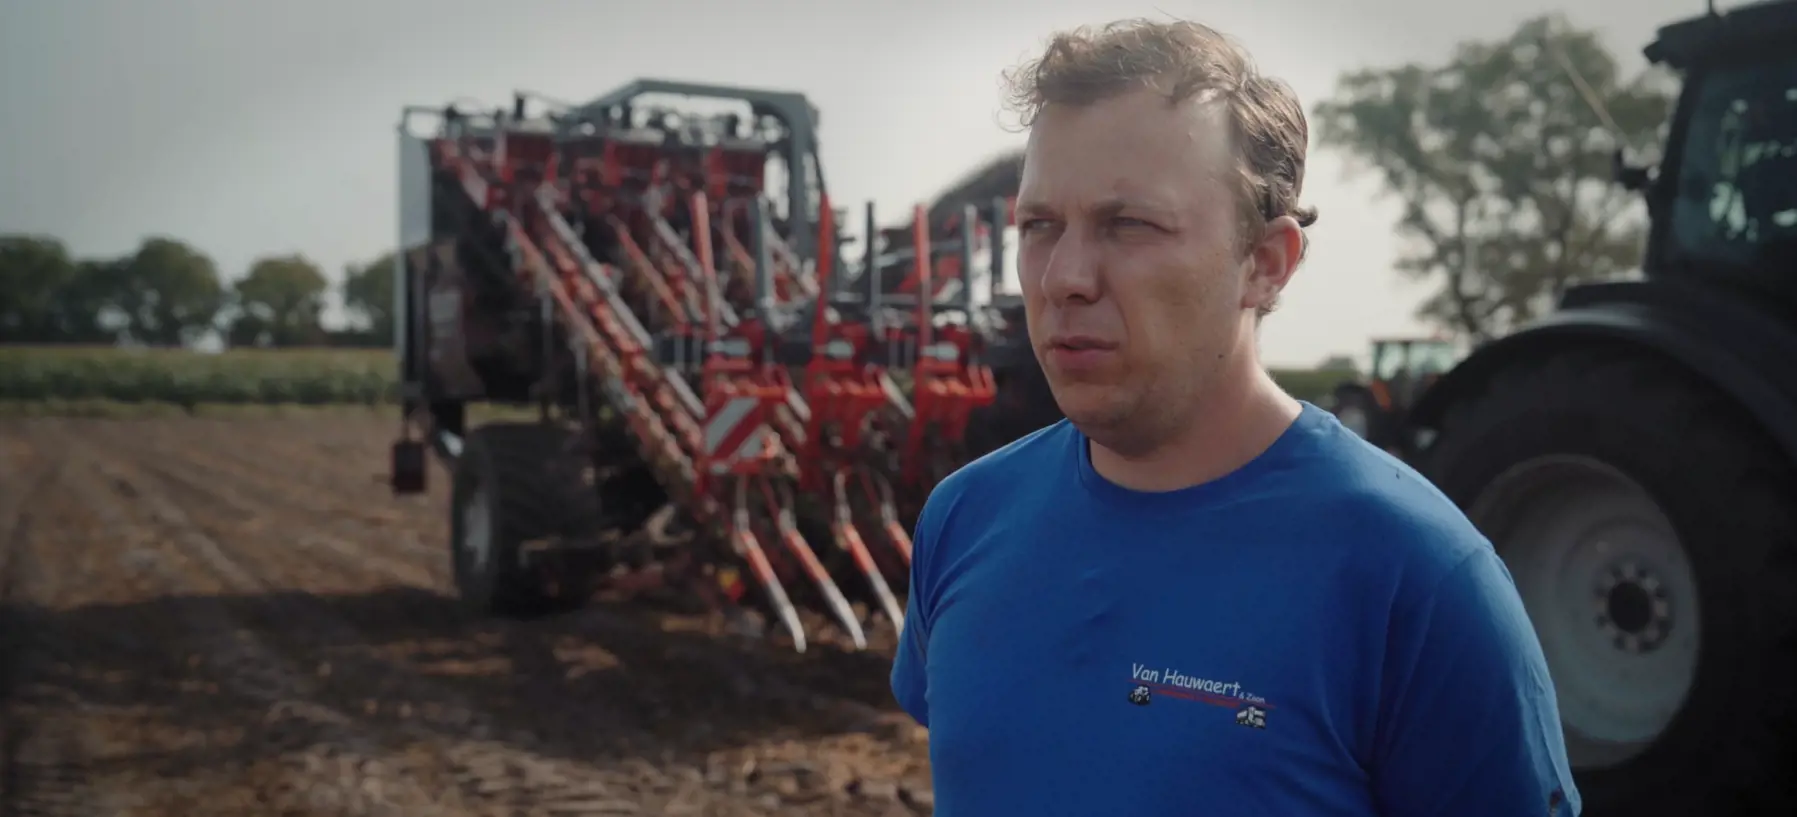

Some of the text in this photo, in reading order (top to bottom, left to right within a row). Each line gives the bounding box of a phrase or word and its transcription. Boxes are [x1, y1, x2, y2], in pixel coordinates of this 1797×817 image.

[1132, 663, 1159, 682] Van
[1163, 668, 1241, 696] Hauwaert
[1246, 692, 1265, 703] Zoon
